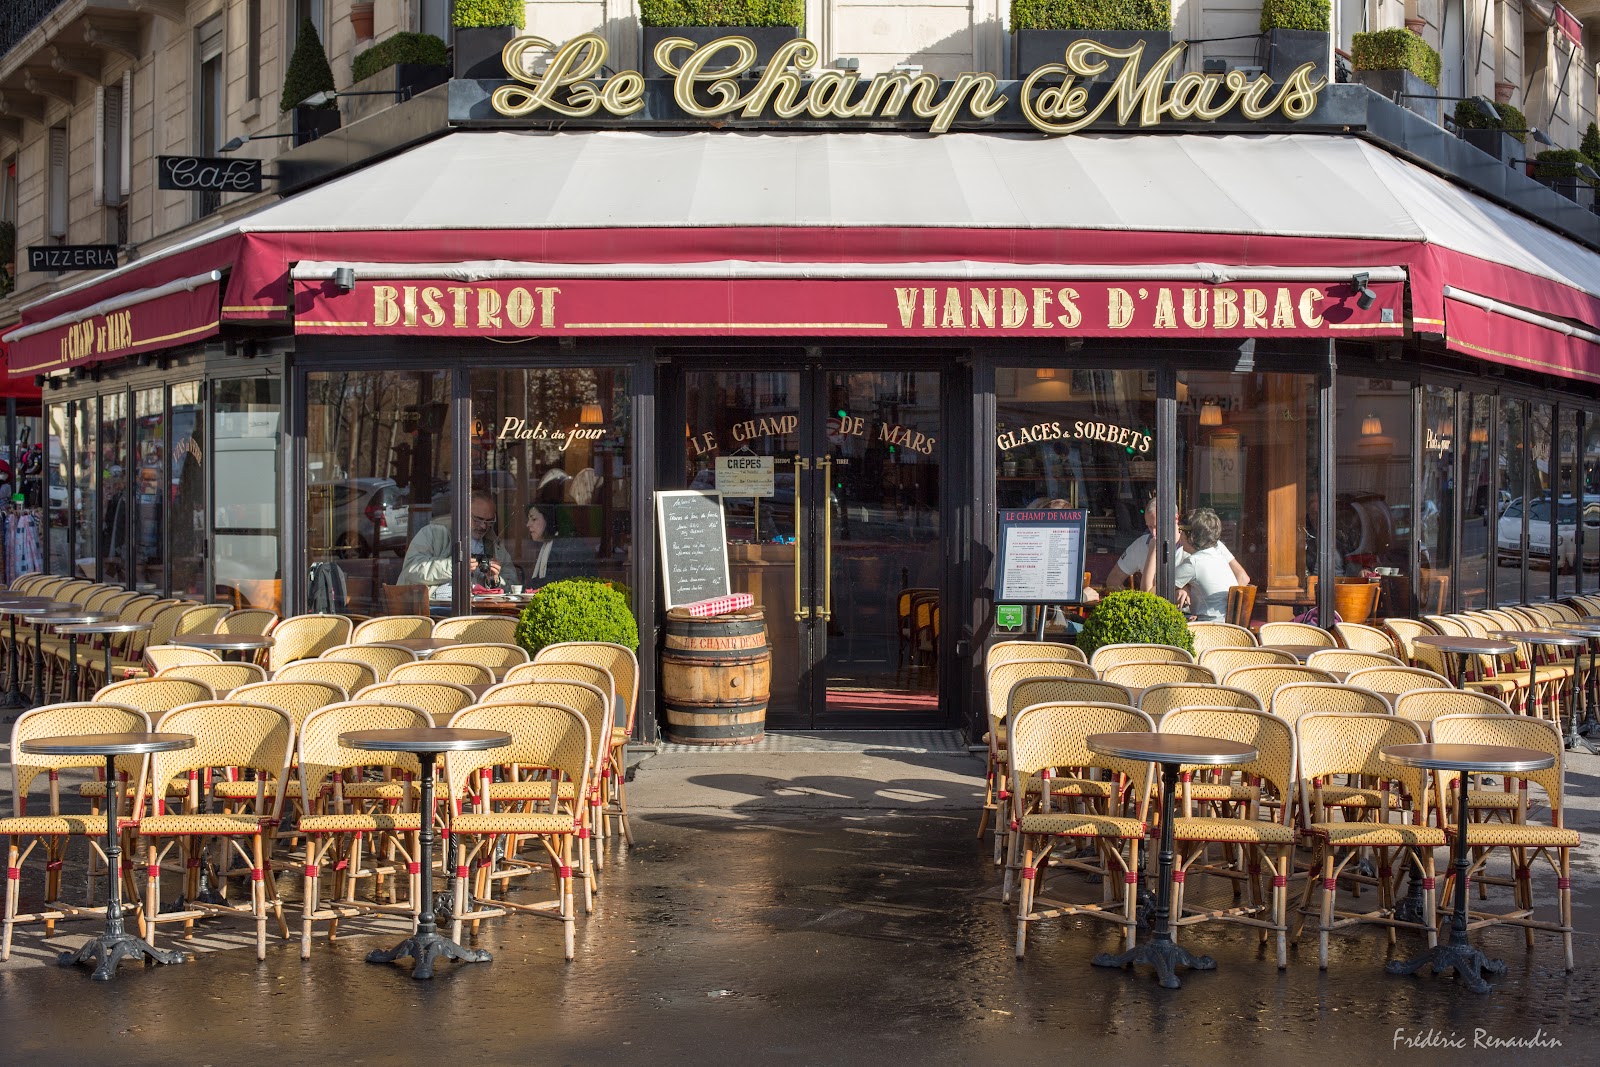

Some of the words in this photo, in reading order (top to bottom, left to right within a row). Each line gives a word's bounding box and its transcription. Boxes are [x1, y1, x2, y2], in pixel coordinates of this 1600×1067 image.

[492, 33, 645, 117] Le
[654, 36, 1008, 133] Champ
[1021, 39, 1328, 133] Mars
[1036, 75, 1087, 118] de
[166, 158, 258, 190] Café
[33, 249, 115, 267] PIZZERIA
[373, 285, 562, 328] BISTROT
[895, 286, 1083, 329] VIANDES
[1107, 287, 1326, 330] D'AUBRAC
[61, 337, 69, 362] LE
[68, 319, 95, 361] CHAMP
[97, 326, 107, 354] DE
[105, 309, 132, 352] MARS
[498, 416, 549, 440] Plats
[550, 429, 566, 440] du
[558, 423, 607, 452] jour
[691, 431, 718, 456] LE
[732, 415, 798, 442] CHAMP
[839, 415, 865, 437] DE
[878, 422, 936, 455] MARS
[997, 421, 1062, 451] GLACES
[1062, 430, 1071, 438] &
[1074, 420, 1153, 453] SORBETS
[727, 458, 762, 469] CRÊPES
[1006, 512, 1015, 521] LE
[1016, 511, 1046, 521] CHAMP
[1047, 511, 1058, 521] DE
[1059, 511, 1082, 520] MARS
[684, 637, 697, 649] LE
